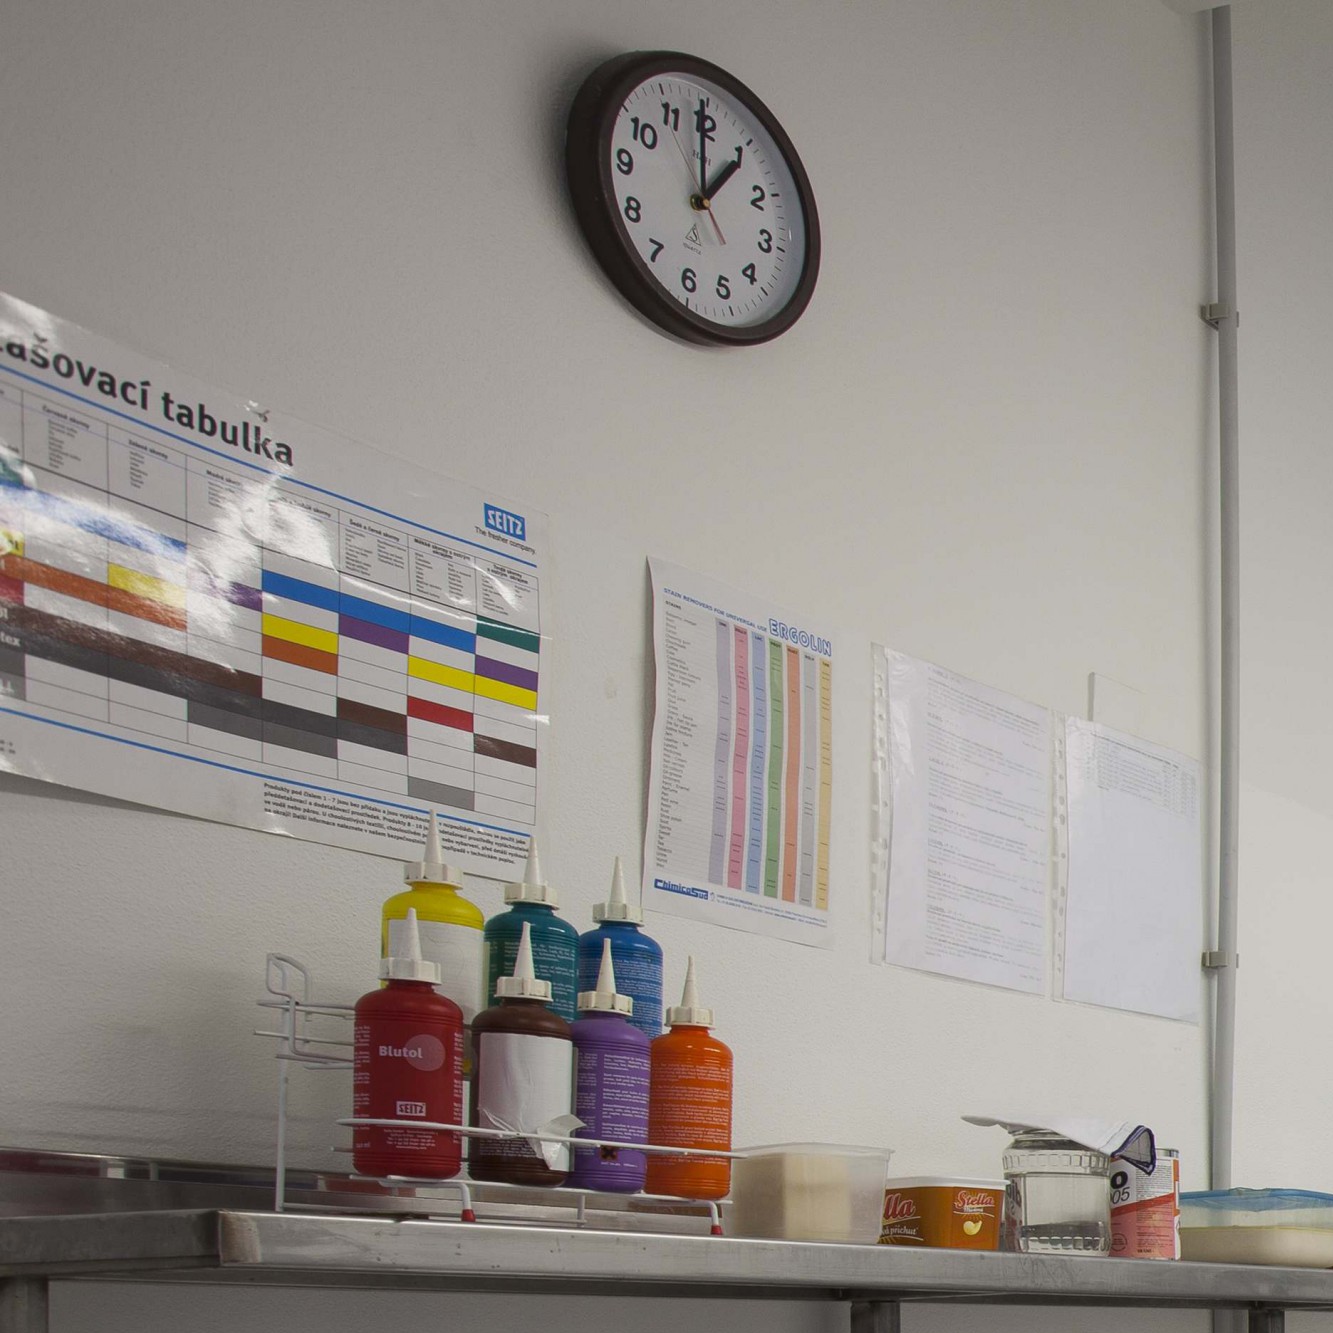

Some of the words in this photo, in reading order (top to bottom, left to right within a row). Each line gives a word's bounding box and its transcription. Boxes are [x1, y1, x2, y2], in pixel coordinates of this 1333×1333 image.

[661, 102, 680, 131] 11
[631, 116, 658, 150] 10
[616, 148, 634, 175] 9
[624, 196, 641, 223] 8
[750, 185, 766, 211] 2
[649, 238, 664, 263] 7
[758, 229, 773, 253] 3
[681, 268, 697, 293] 6
[742, 263, 758, 285] 4
[716, 275, 731, 300] 5
[0, 333, 150, 411] ašovací
[161, 391, 294, 467] tabulka
[475, 526, 487, 538] The
[488, 529, 508, 545] fresher
[487, 510, 523, 536] SEITZ
[769, 618, 832, 657] ERGOLIN
[379, 1045, 423, 1058] Blutol
[399, 1104, 424, 1114] SEITZ
[955, 1190, 995, 1209] Stella
